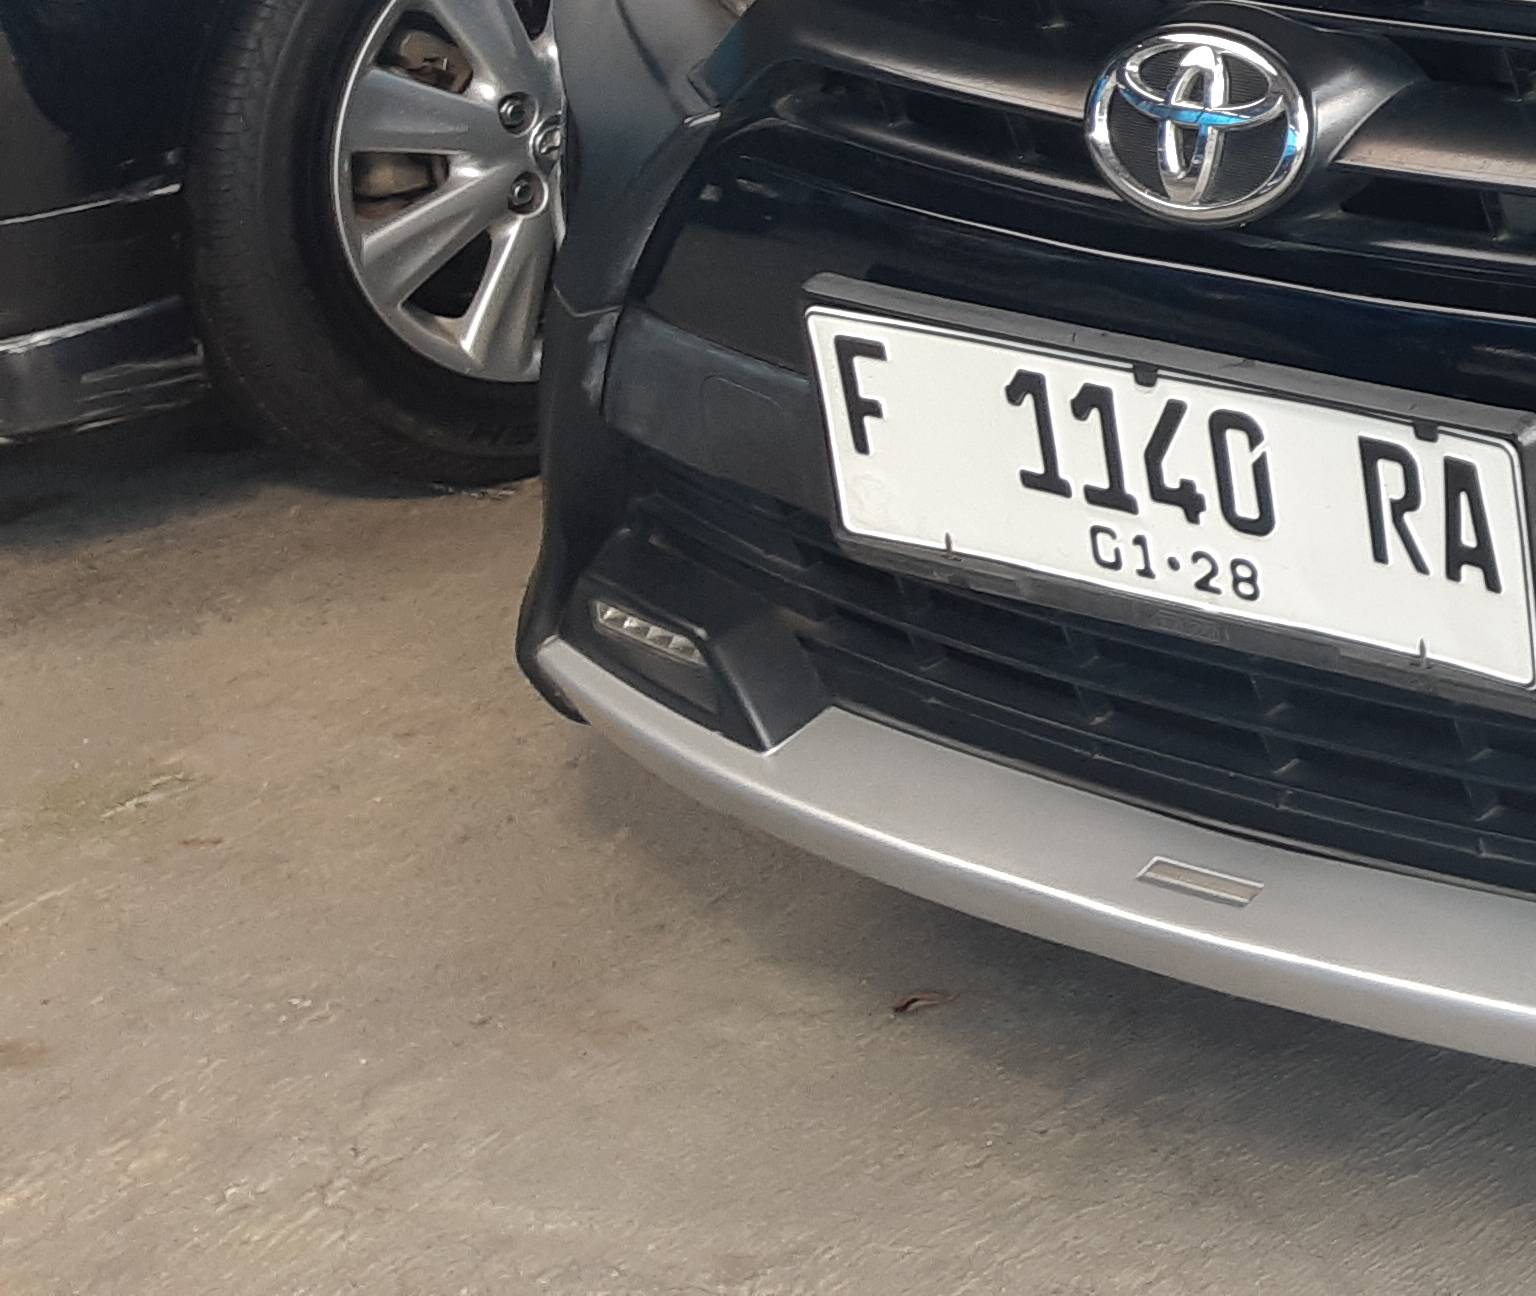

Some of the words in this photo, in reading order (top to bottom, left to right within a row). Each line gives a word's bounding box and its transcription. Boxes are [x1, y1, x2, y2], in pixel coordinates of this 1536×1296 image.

[833, 334, 887, 456] F
[1004, 369, 1277, 538] 1140
[1357, 435, 1503, 595] RA
